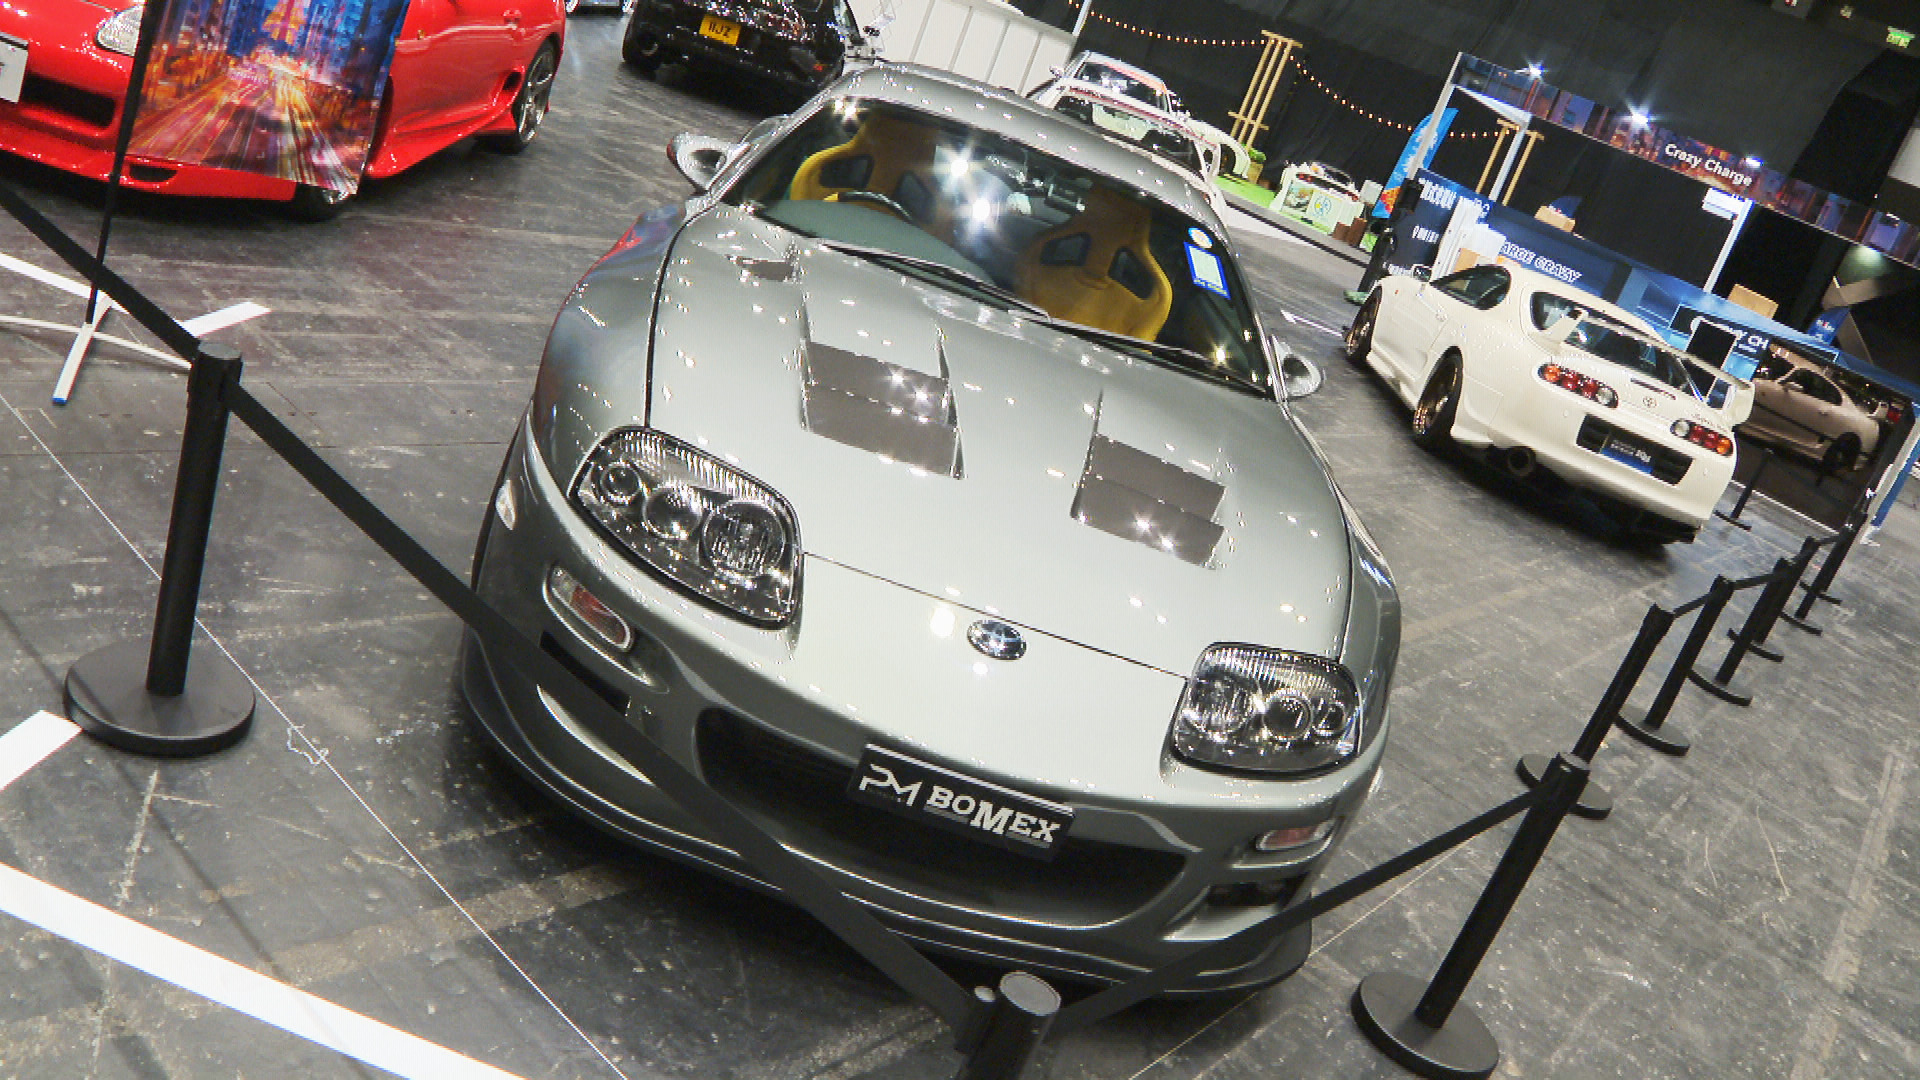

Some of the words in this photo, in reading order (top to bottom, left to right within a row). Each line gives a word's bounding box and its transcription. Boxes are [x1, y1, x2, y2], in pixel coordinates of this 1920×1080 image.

[1664, 143, 1703, 169] Crazy
[1704, 159, 1753, 187] Charge
[1535, 255, 1583, 285] CRAZY
[926, 784, 1061, 843] BOMEX
